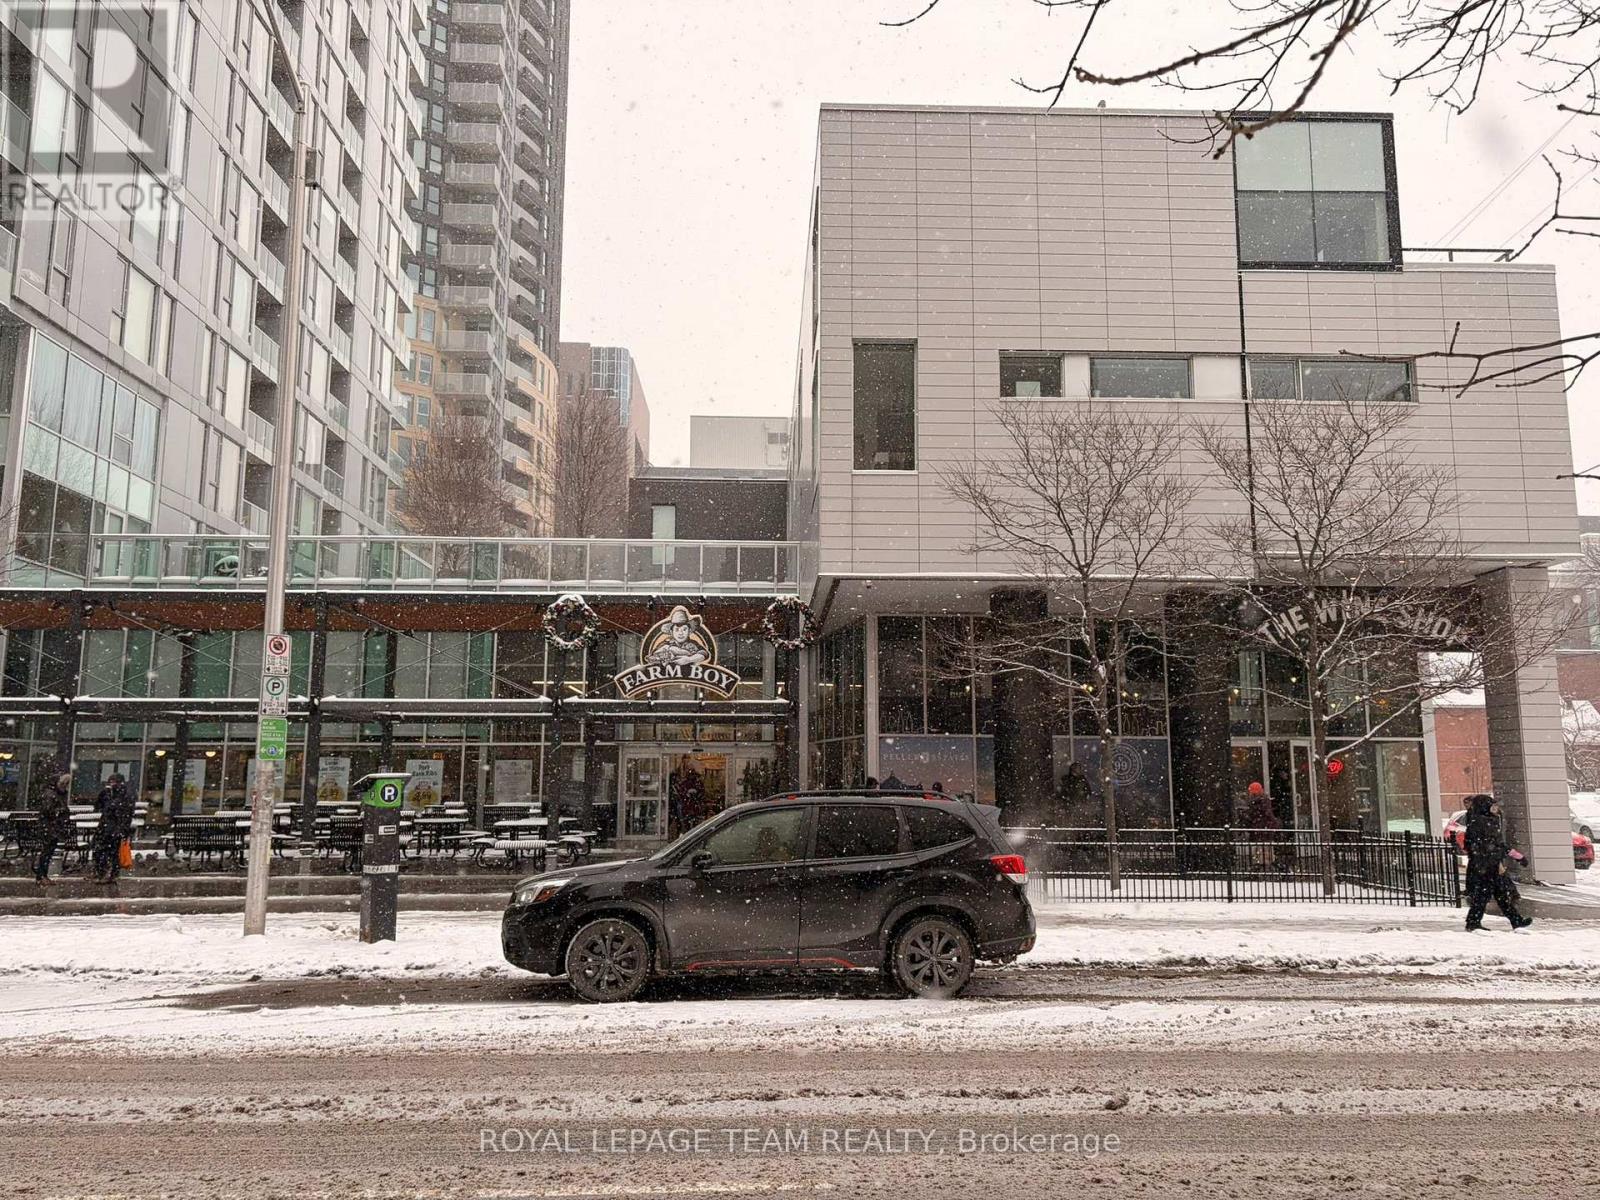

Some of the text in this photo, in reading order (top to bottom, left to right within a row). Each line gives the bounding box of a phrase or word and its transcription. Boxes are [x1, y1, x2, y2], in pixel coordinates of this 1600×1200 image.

[1257, 605, 1310, 644] THE
[272, 682, 280, 691] P
[620, 665, 735, 692] FARM BOY
[384, 786, 395, 800] P
